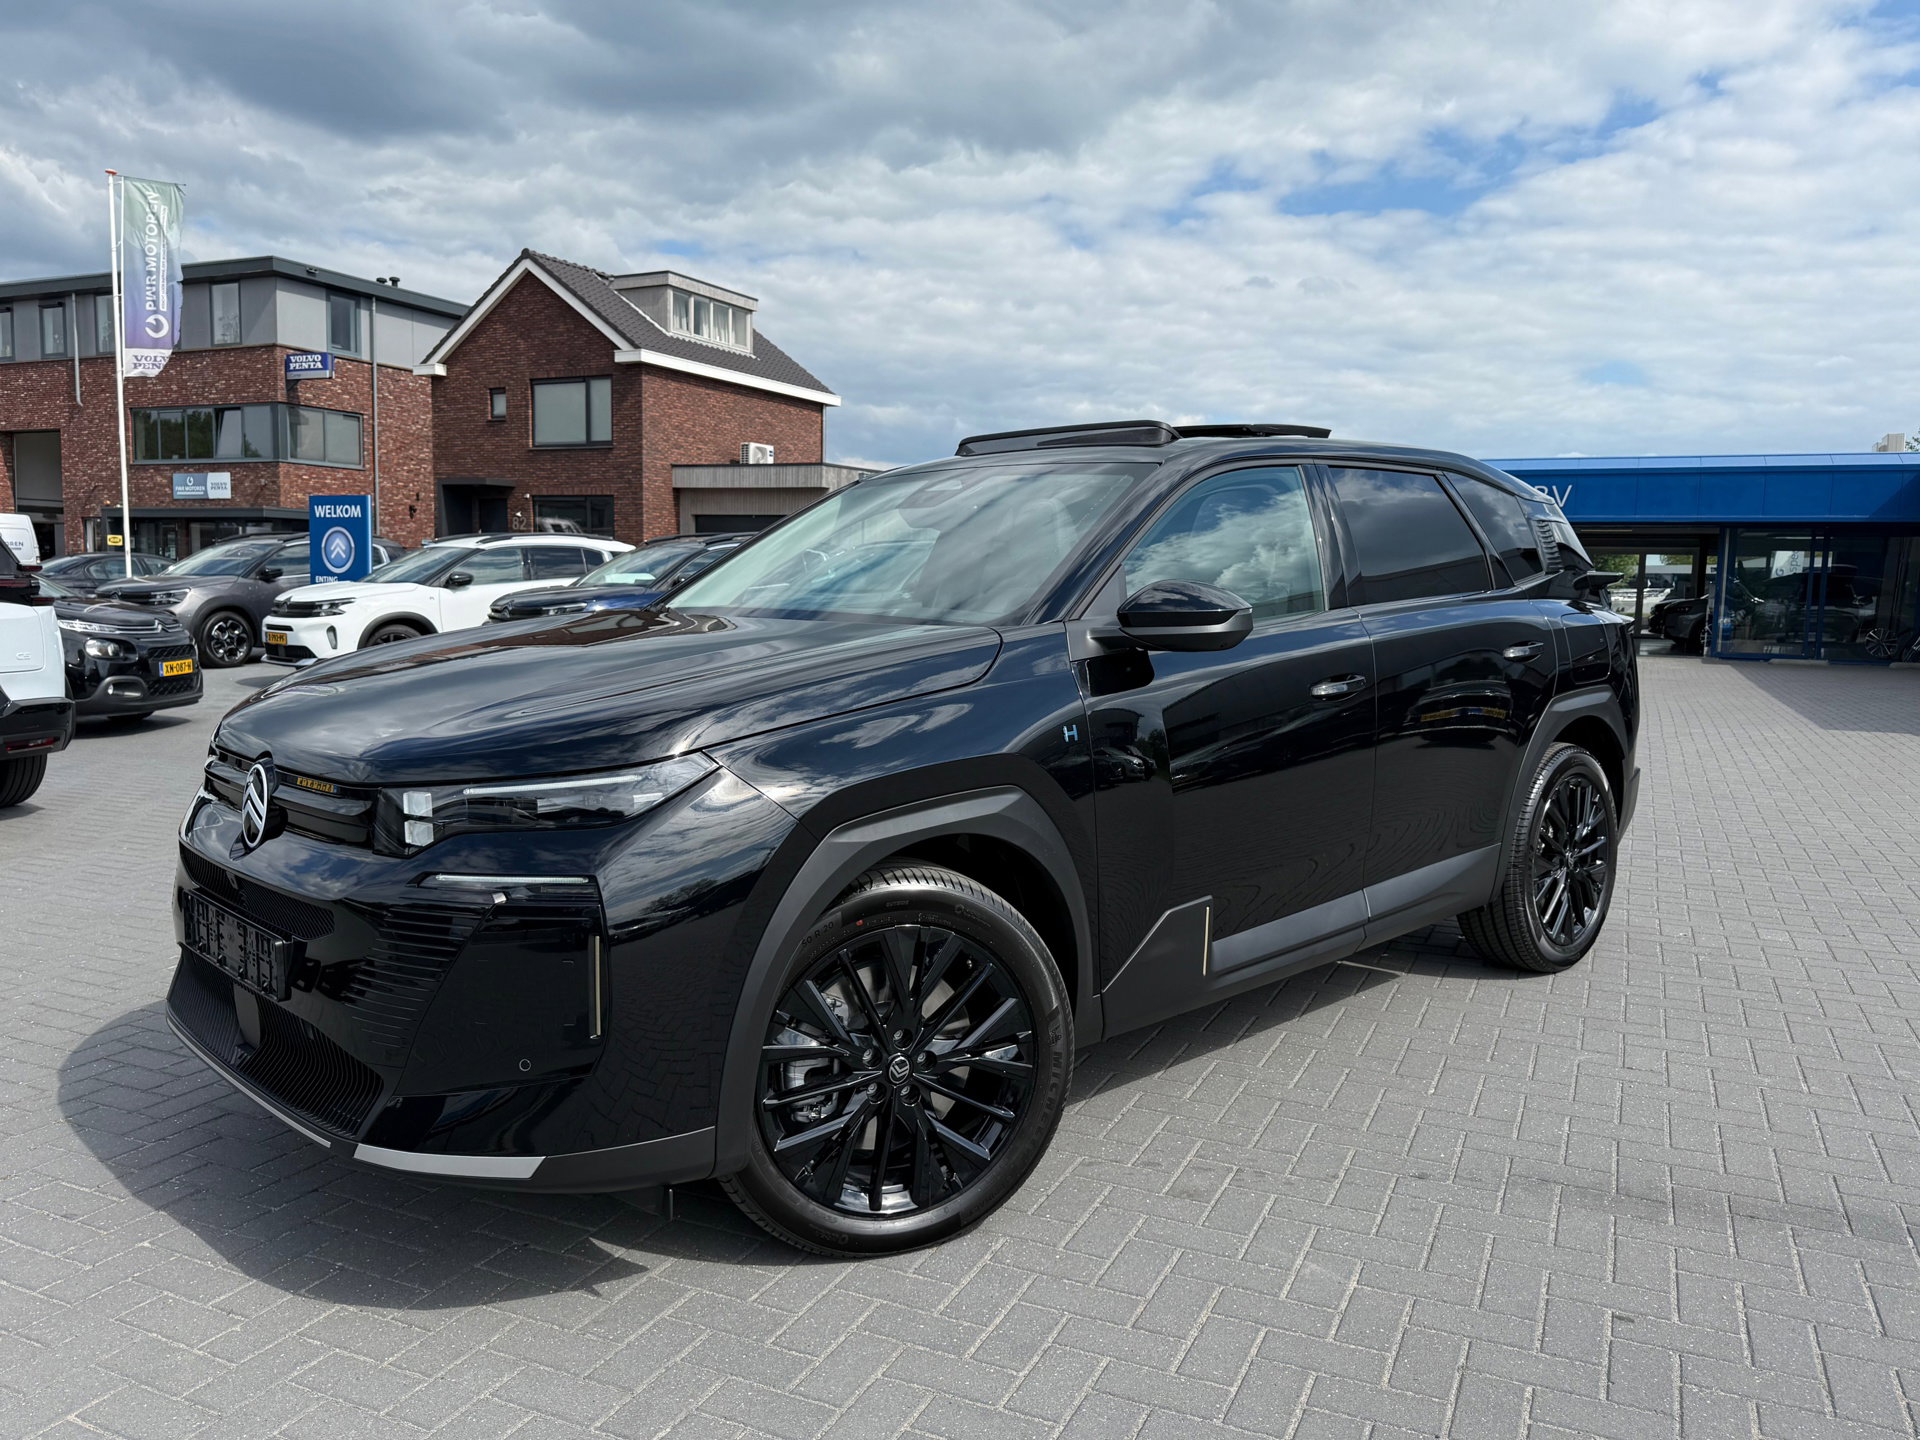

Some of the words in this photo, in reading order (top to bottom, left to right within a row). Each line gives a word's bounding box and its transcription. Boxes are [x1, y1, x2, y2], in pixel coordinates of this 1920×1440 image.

[132, 355, 169, 363] VOLV
[289, 354, 322, 363] VOLVO
[132, 362, 162, 370] PEN
[289, 361, 324, 370] PENTA
[314, 504, 362, 518] WELKOM
[512, 516, 527, 530] 82
